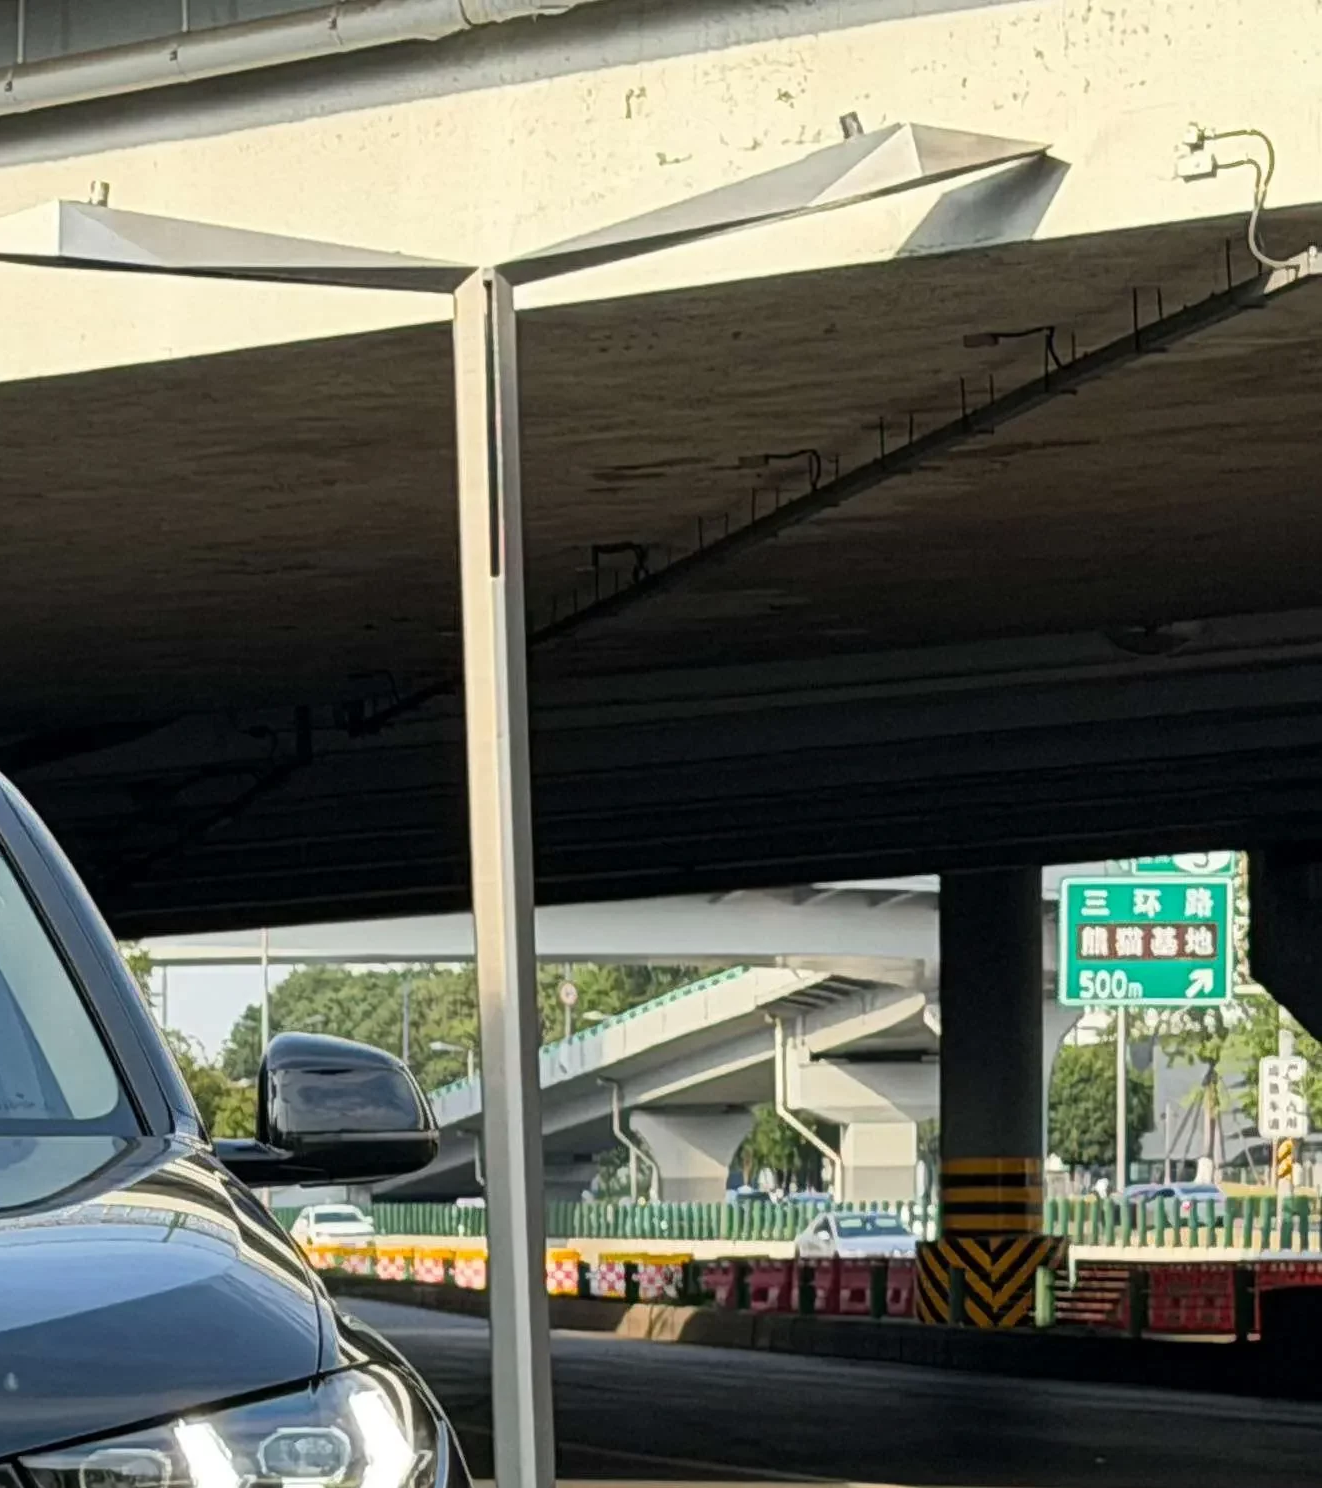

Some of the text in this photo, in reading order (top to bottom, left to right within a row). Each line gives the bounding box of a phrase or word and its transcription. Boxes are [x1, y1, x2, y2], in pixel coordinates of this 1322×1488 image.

[1081, 887, 1215, 918] 三环路
[1079, 969, 1143, 998] 500m
